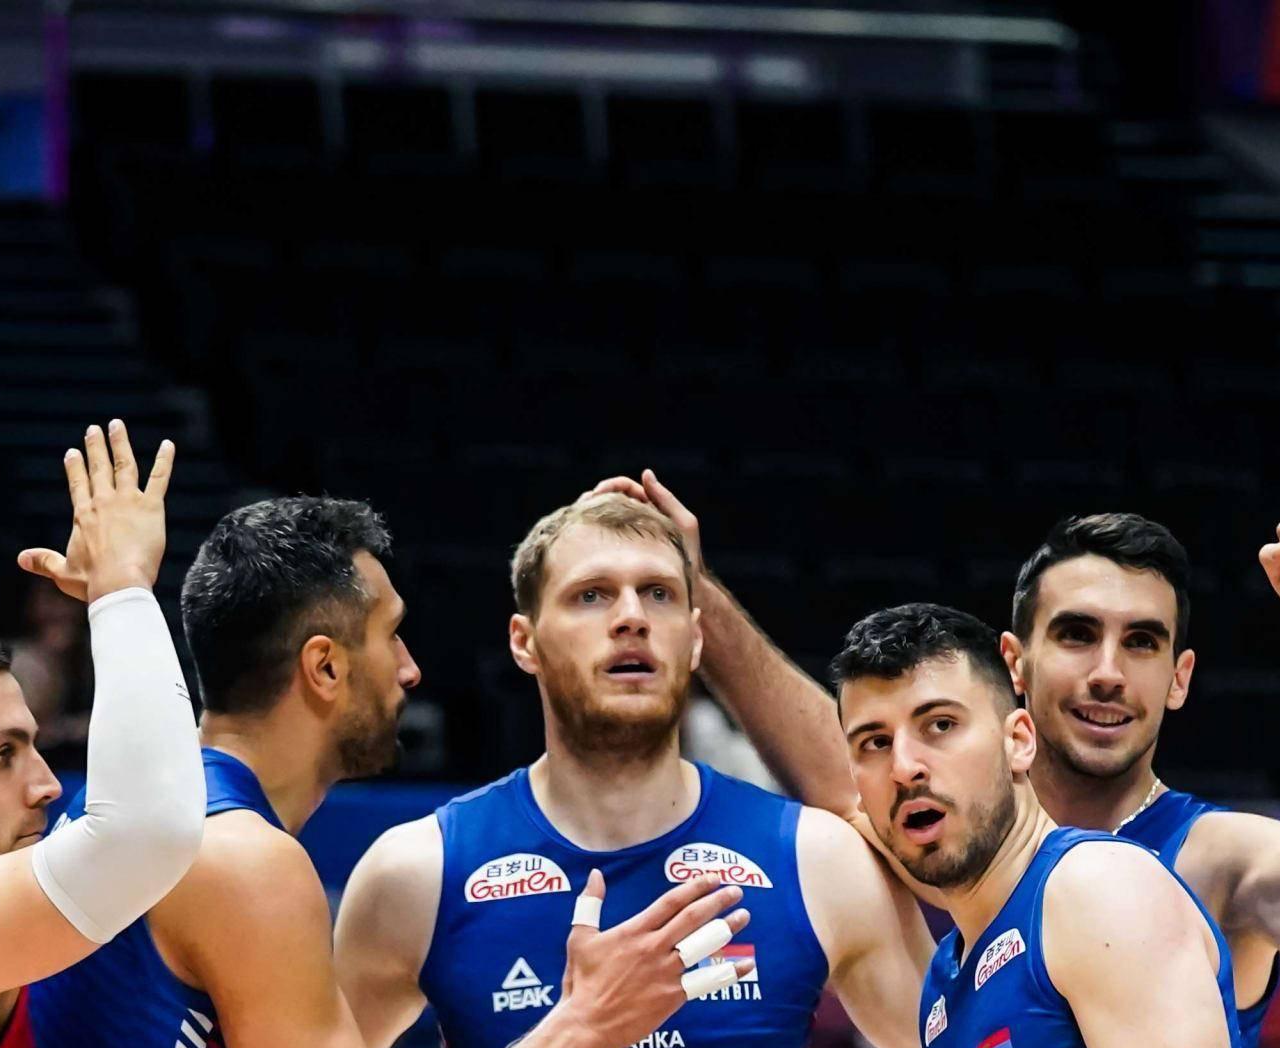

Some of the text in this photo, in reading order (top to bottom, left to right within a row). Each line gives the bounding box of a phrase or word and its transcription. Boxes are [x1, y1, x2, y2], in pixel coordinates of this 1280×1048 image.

[682, 848, 739, 864] 百岁山
[486, 858, 542, 878] 百岁山
[492, 984, 554, 1013] PEAK
